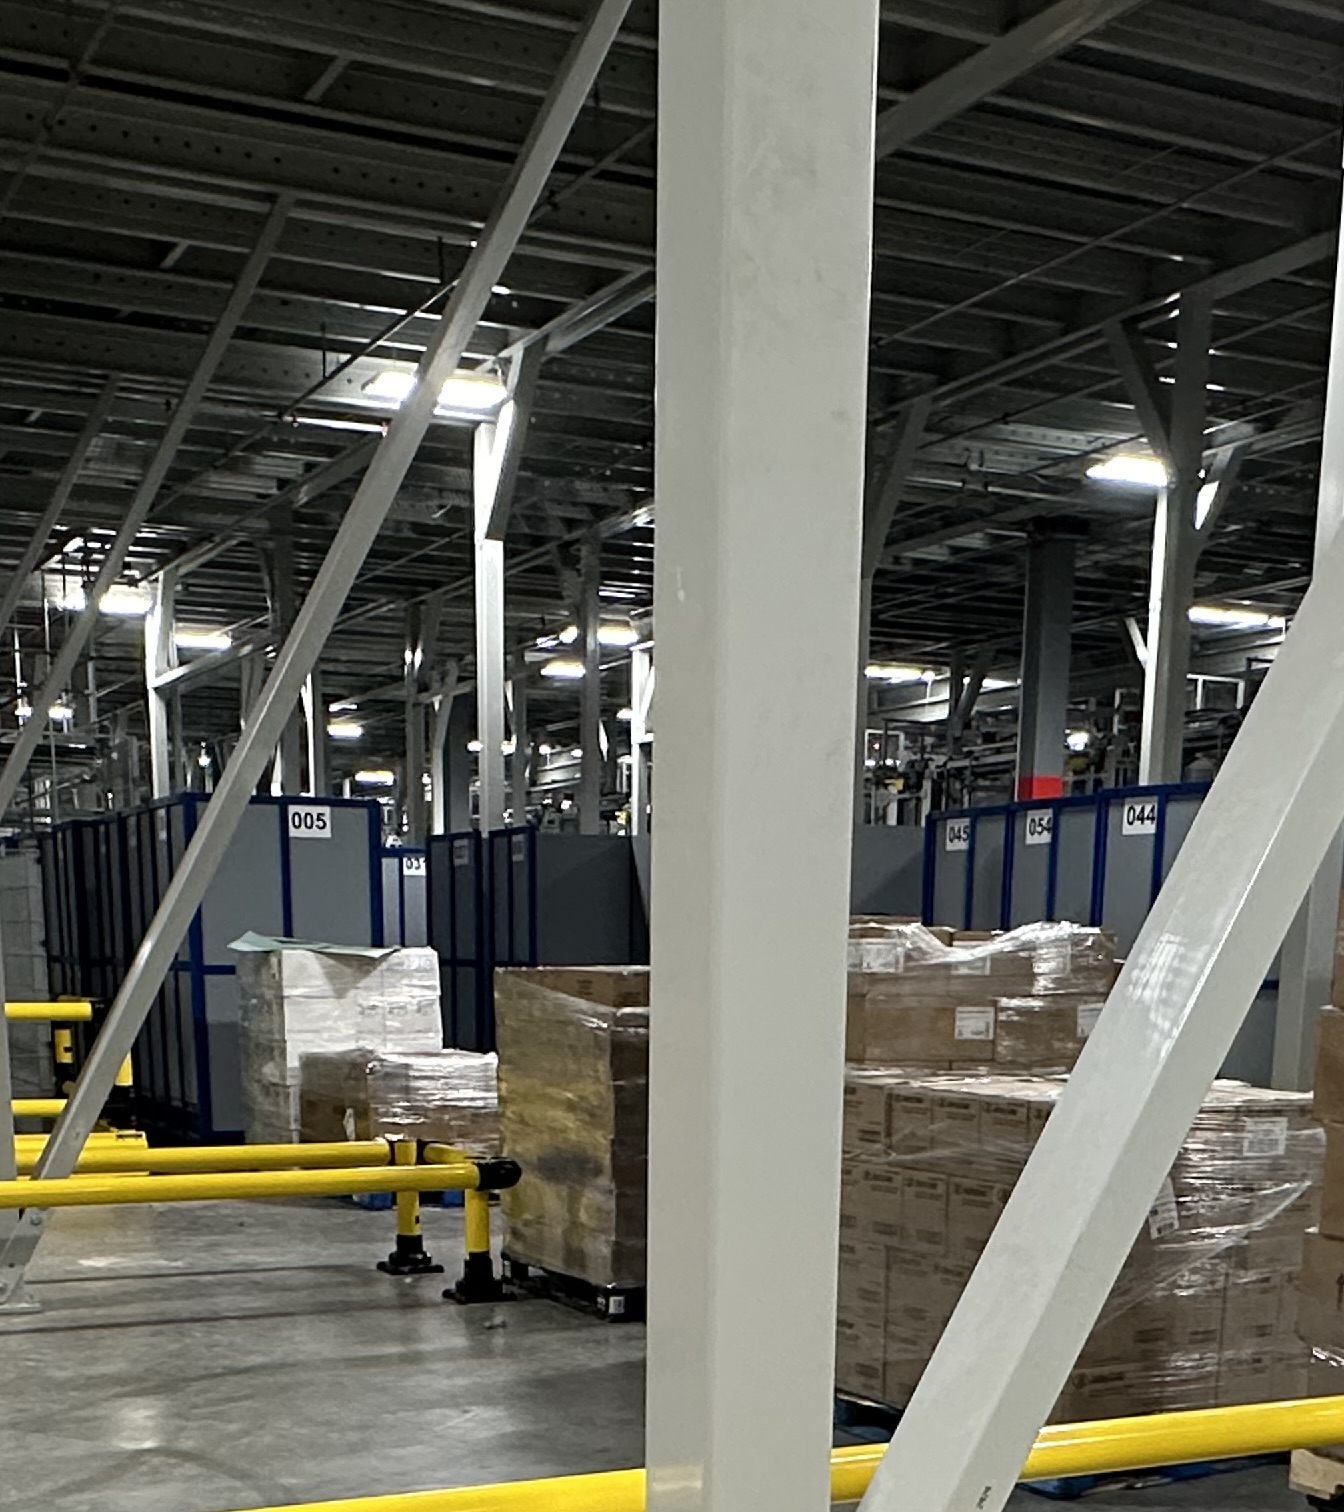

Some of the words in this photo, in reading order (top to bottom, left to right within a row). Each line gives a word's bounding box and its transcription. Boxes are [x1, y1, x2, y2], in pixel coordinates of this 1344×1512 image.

[291, 811, 328, 830] 005
[1126, 804, 1156, 826] 044
[948, 825, 970, 843] 045
